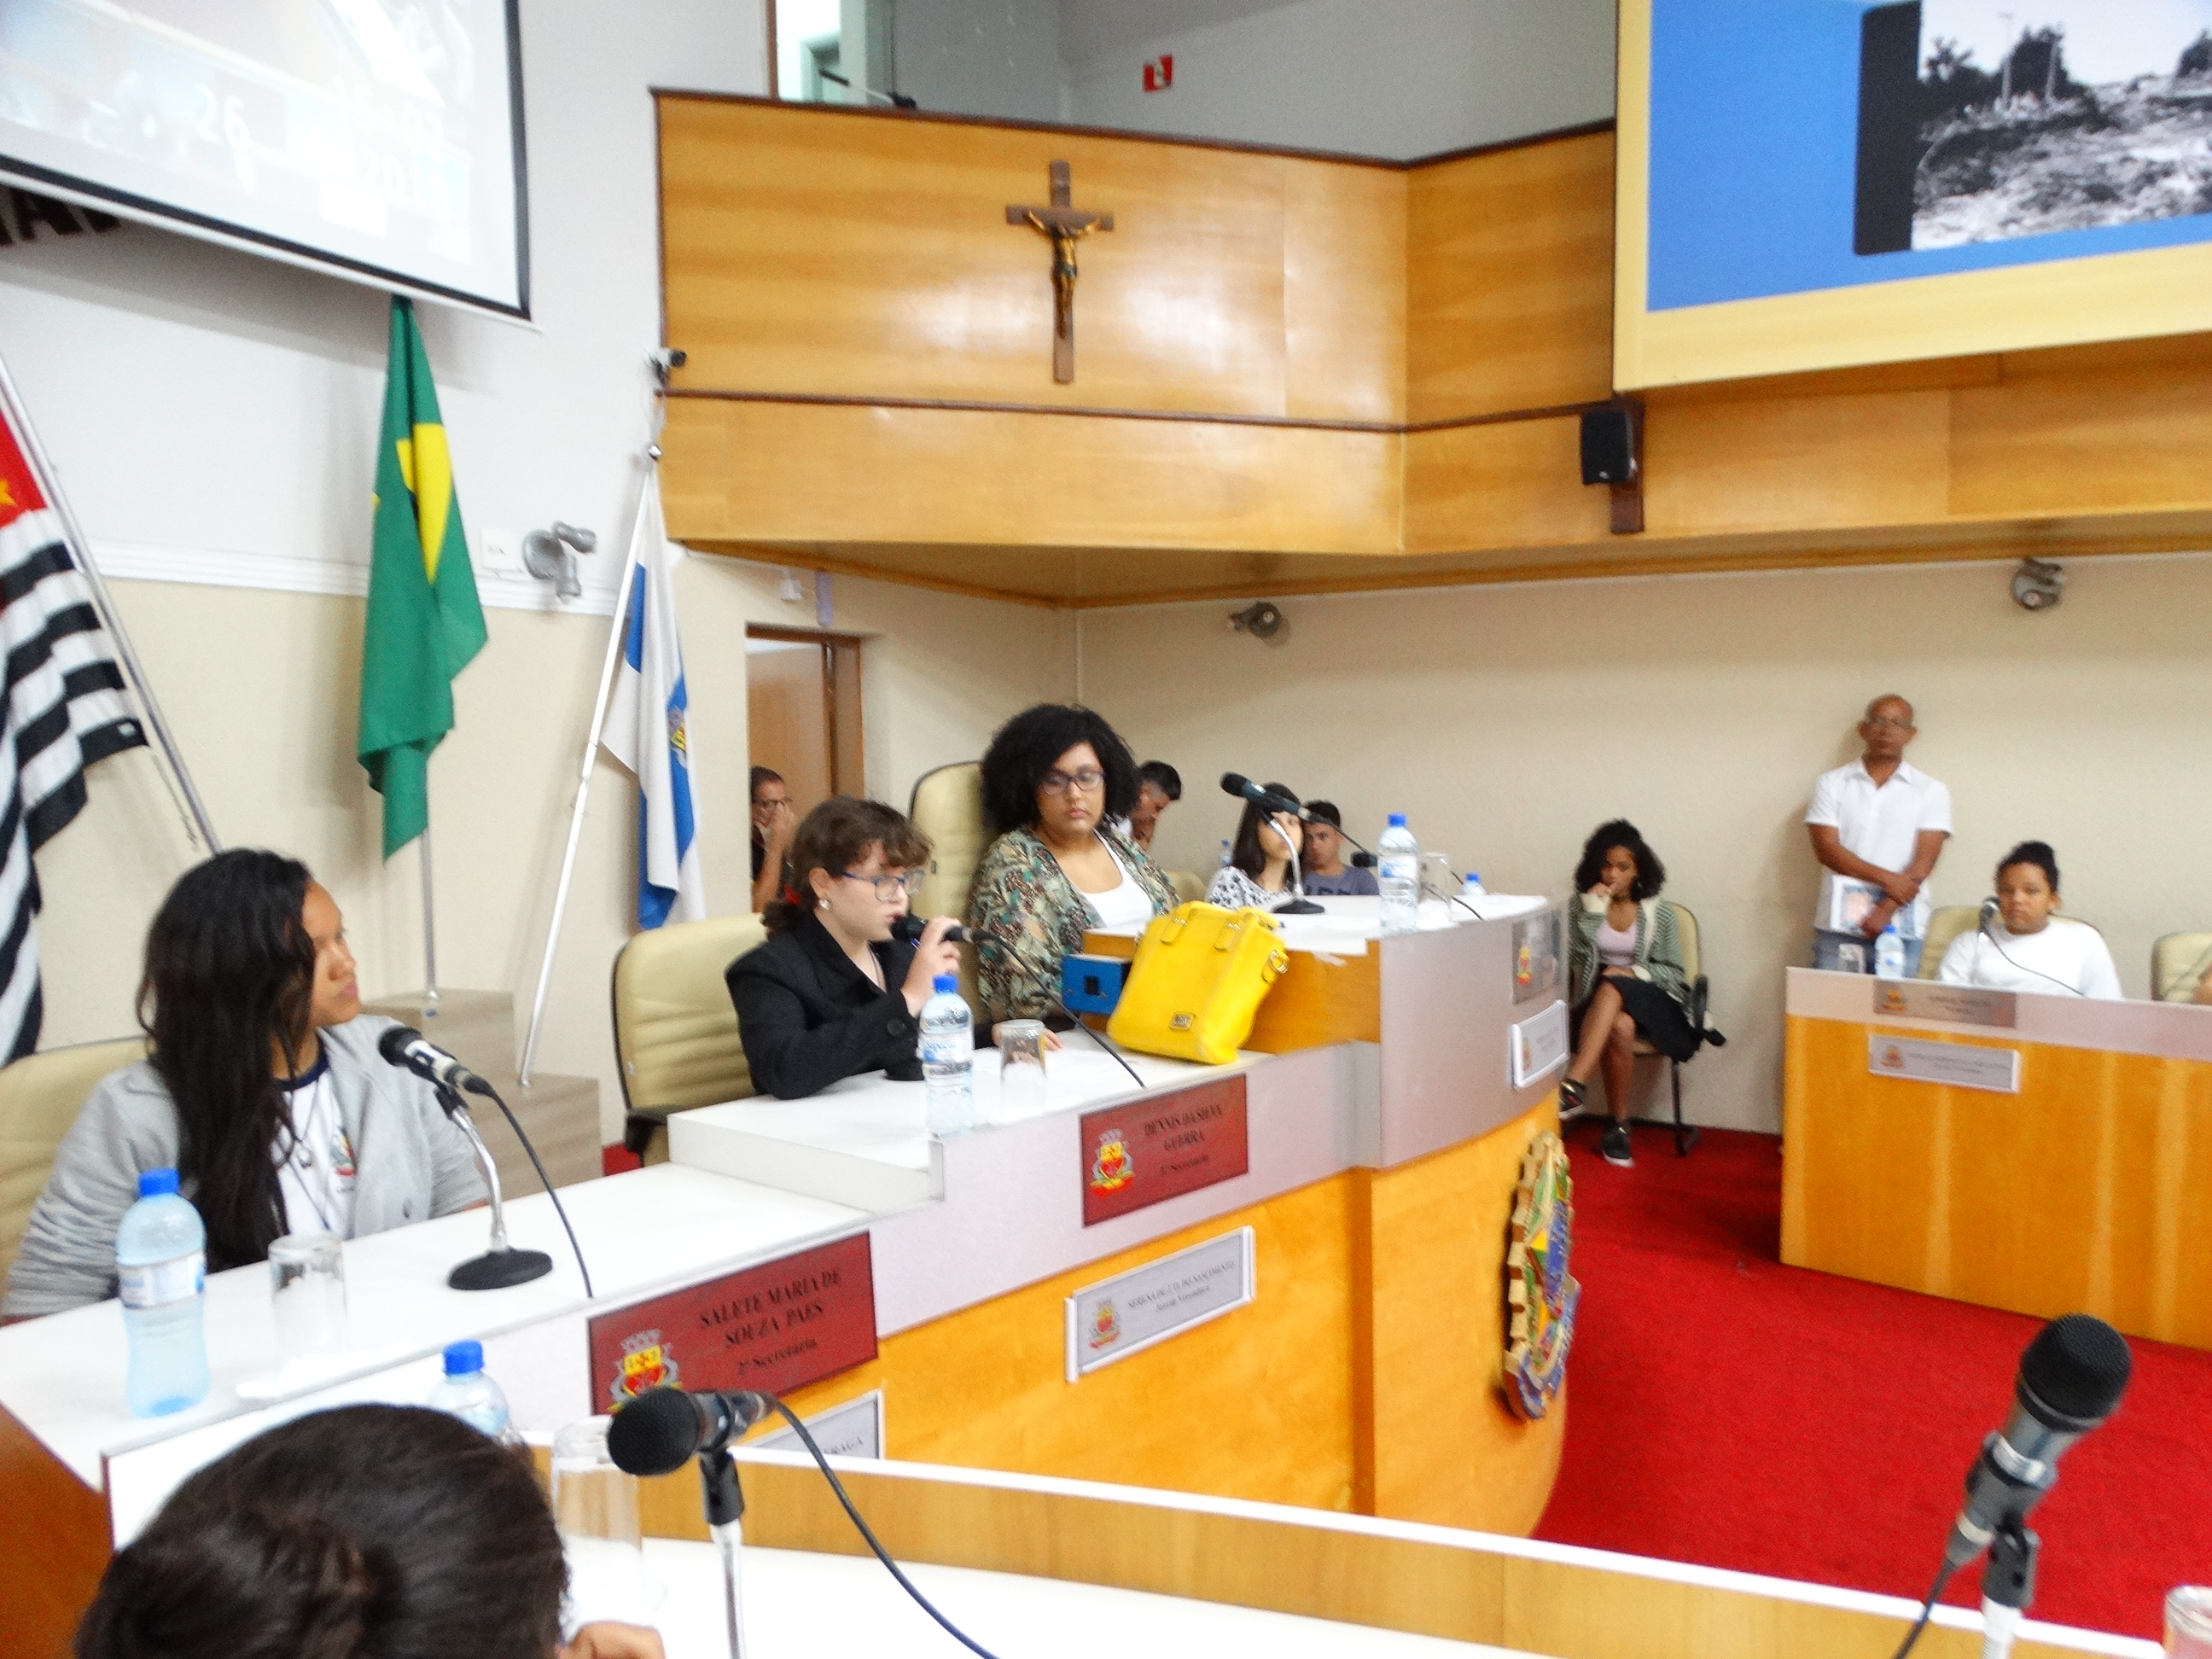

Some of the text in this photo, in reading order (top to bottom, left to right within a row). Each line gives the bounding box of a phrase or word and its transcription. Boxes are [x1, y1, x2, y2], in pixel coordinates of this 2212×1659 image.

[699, 1268, 841, 1330] SALETE MARIA DE
[725, 1297, 824, 1348] SOUZA PAES
